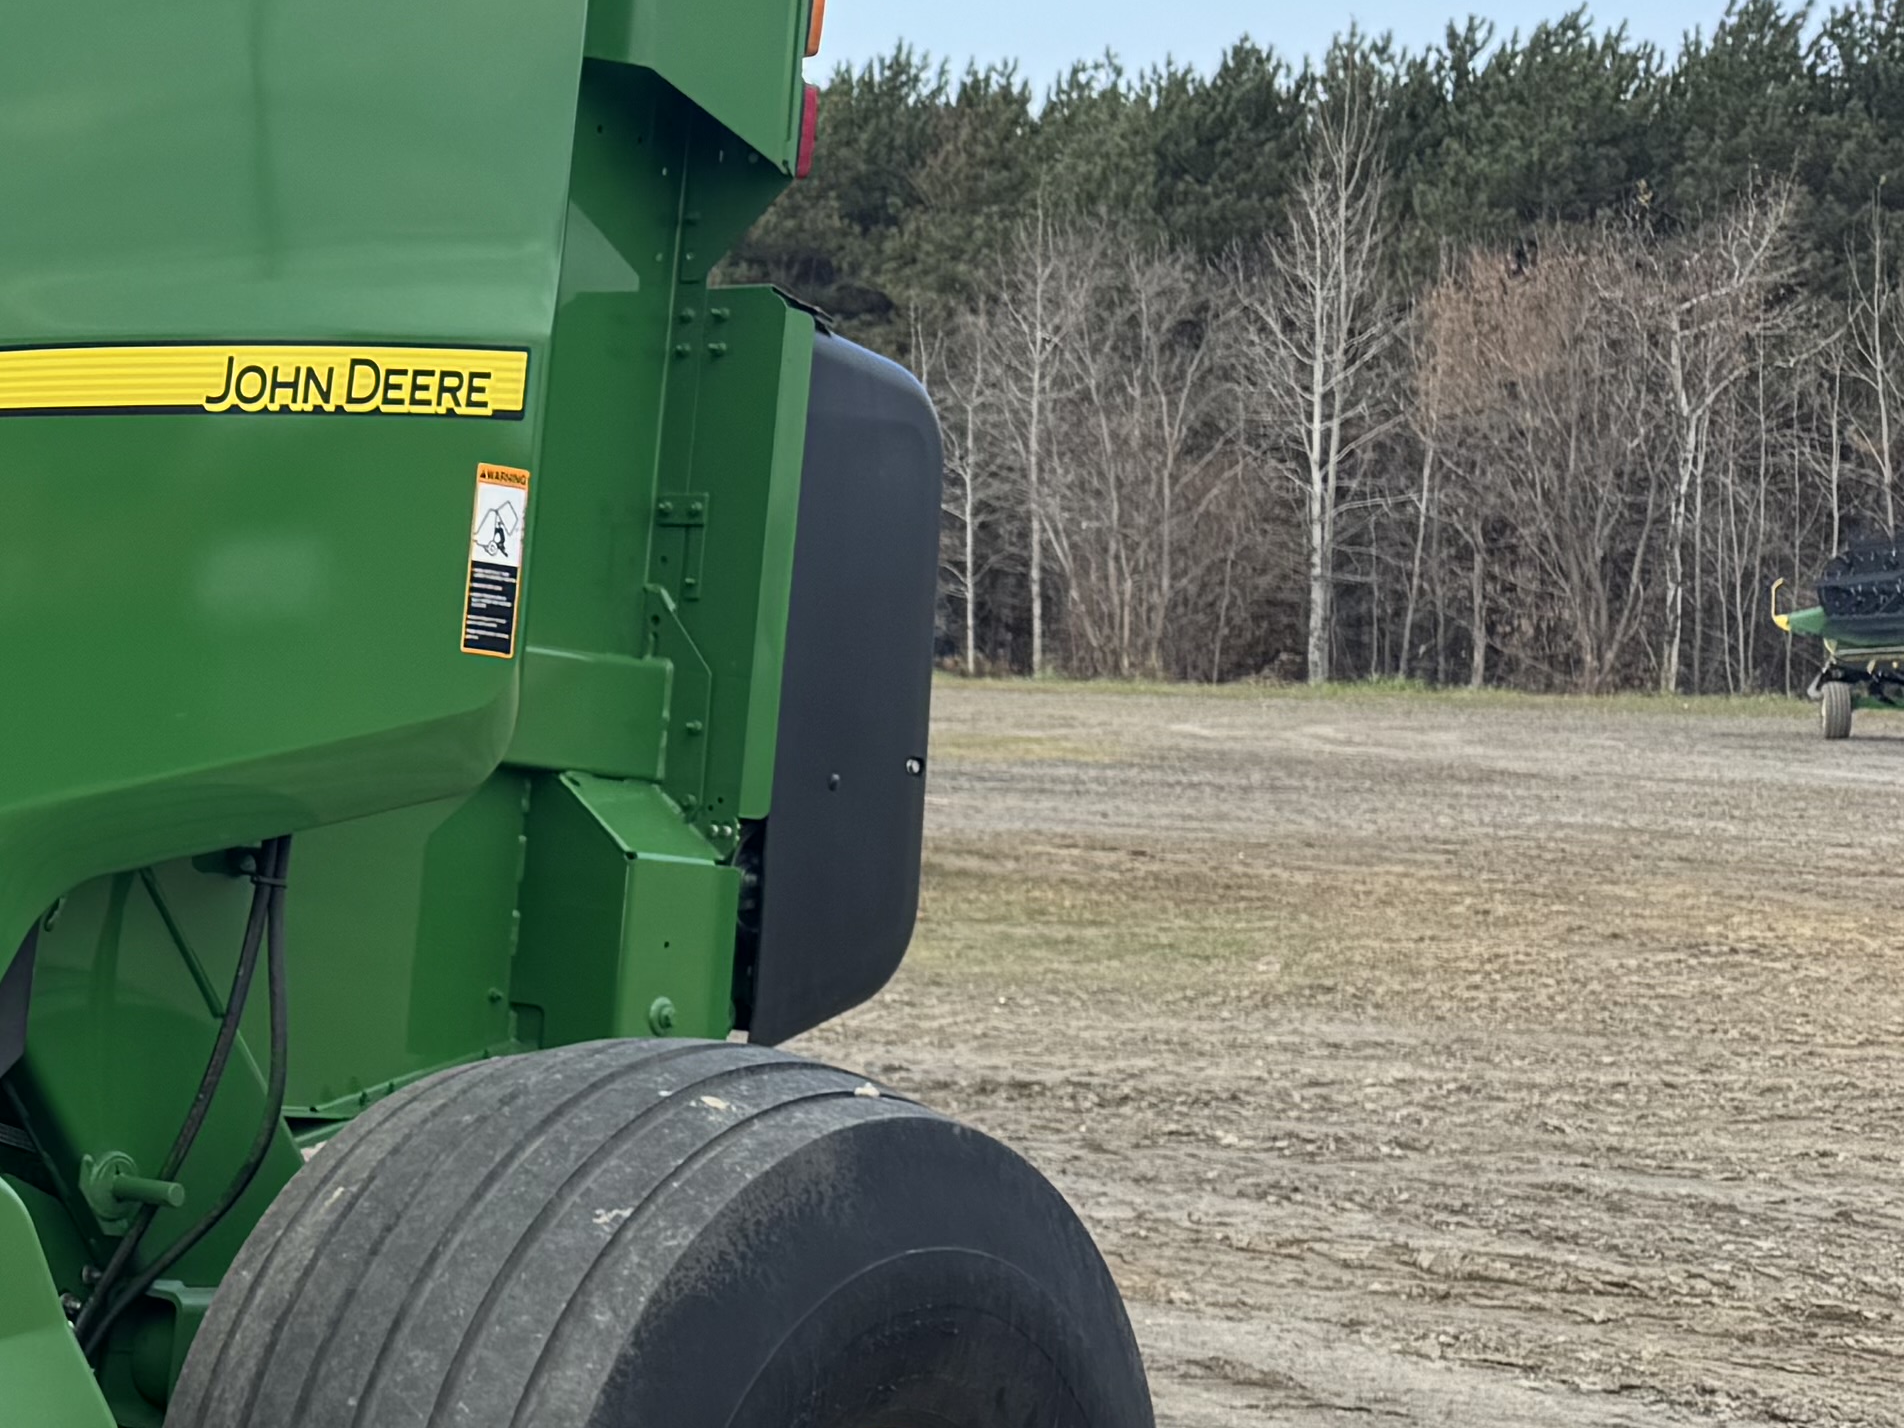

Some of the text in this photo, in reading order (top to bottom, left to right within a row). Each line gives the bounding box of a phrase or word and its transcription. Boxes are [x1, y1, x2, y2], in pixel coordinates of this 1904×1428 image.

[205, 356, 493, 409] JOHN DEERE
[486, 470, 527, 486] WARNING
